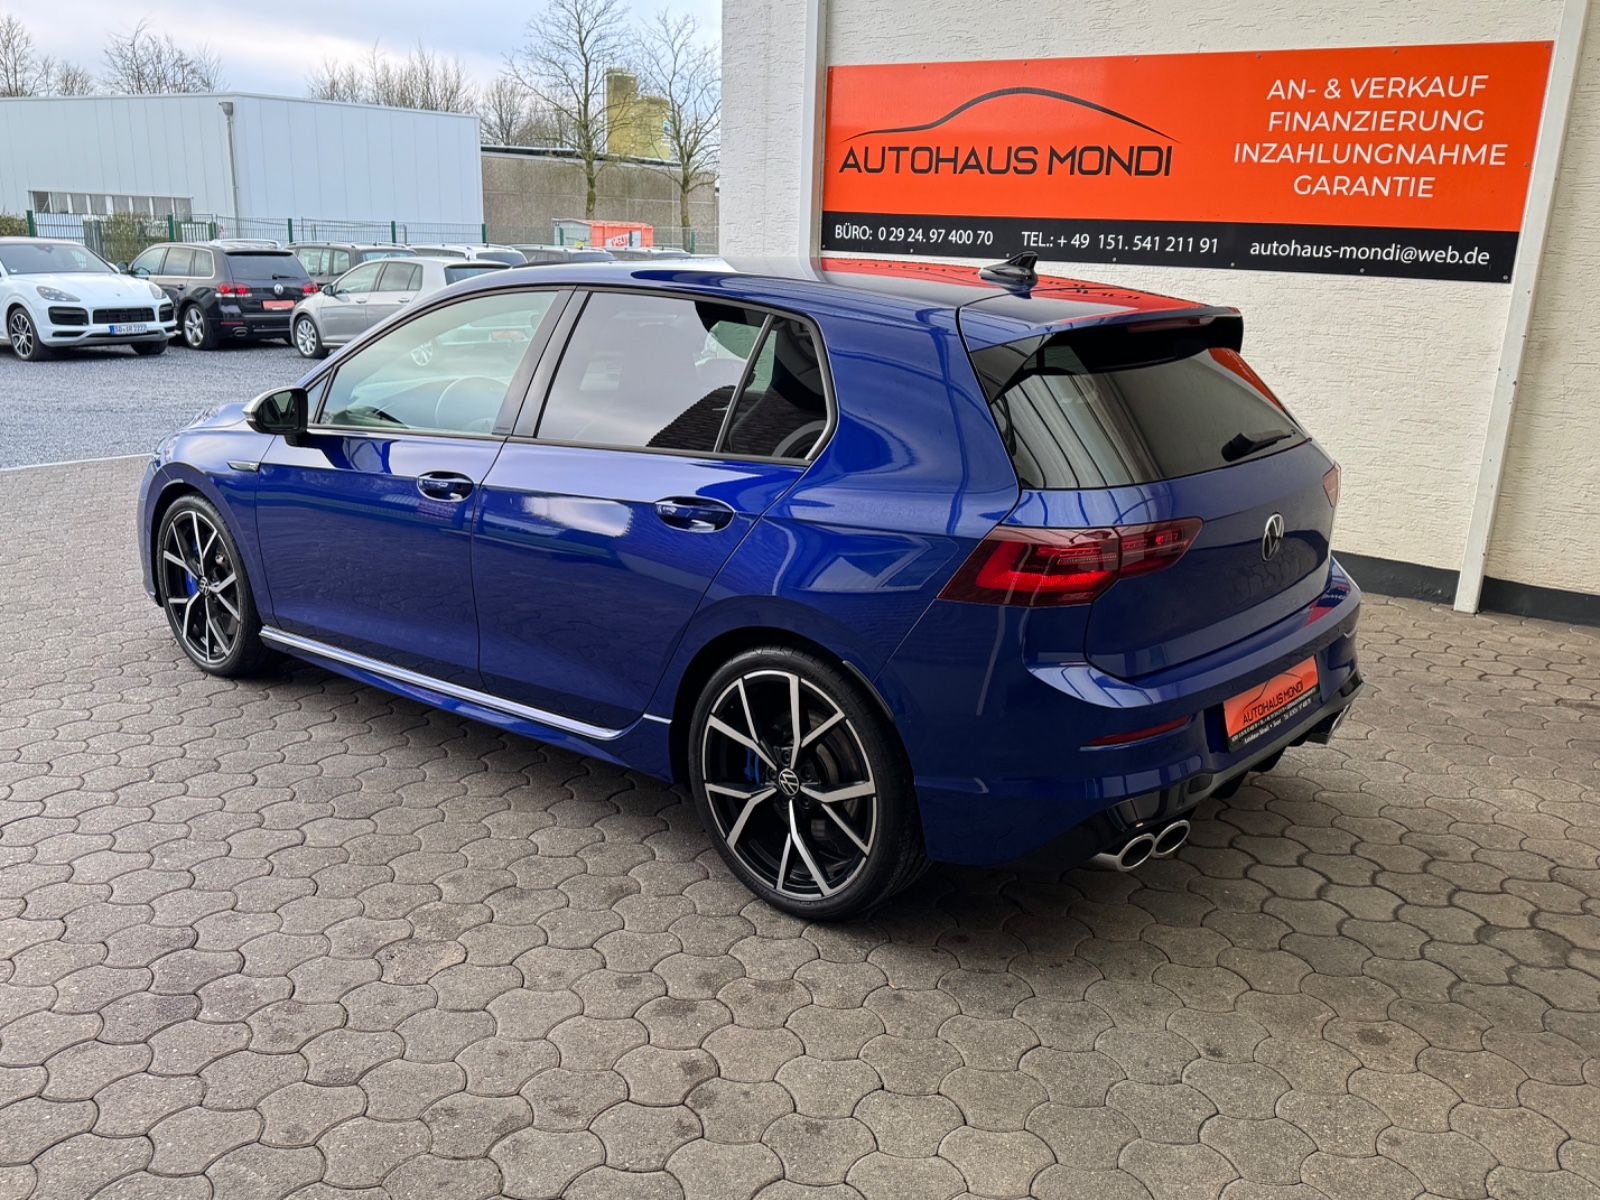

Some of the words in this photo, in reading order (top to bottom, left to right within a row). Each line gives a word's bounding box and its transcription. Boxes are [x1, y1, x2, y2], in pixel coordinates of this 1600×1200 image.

[1266, 79, 1316, 100] AN-
[1323, 78, 1342, 99] &
[1350, 75, 1489, 98] VERKAUF
[1267, 109, 1484, 132] FINANZIERUNG
[839, 145, 1039, 175] AUTOHAUS
[1047, 145, 1173, 177] MONDI
[1233, 143, 1508, 166] INZAHLUNGNAHME
[1293, 174, 1436, 198] GARANTIE
[834, 222, 873, 240] BÜRO:
[878, 226, 887, 241] 0
[888, 227, 905, 242] 29
[906, 227, 927, 243] 24.
[929, 228, 946, 243] 97
[948, 229, 974, 244] 400
[976, 230, 994, 246] 70
[1021, 231, 1054, 247] TEL.:
[1098, 234, 1129, 250] 151.
[1132, 235, 1160, 251] 541
[1165, 236, 1193, 253] 211
[1199, 237, 1218, 254] 91
[1249, 240, 1490, 265] autohaus-mondi@web.de
